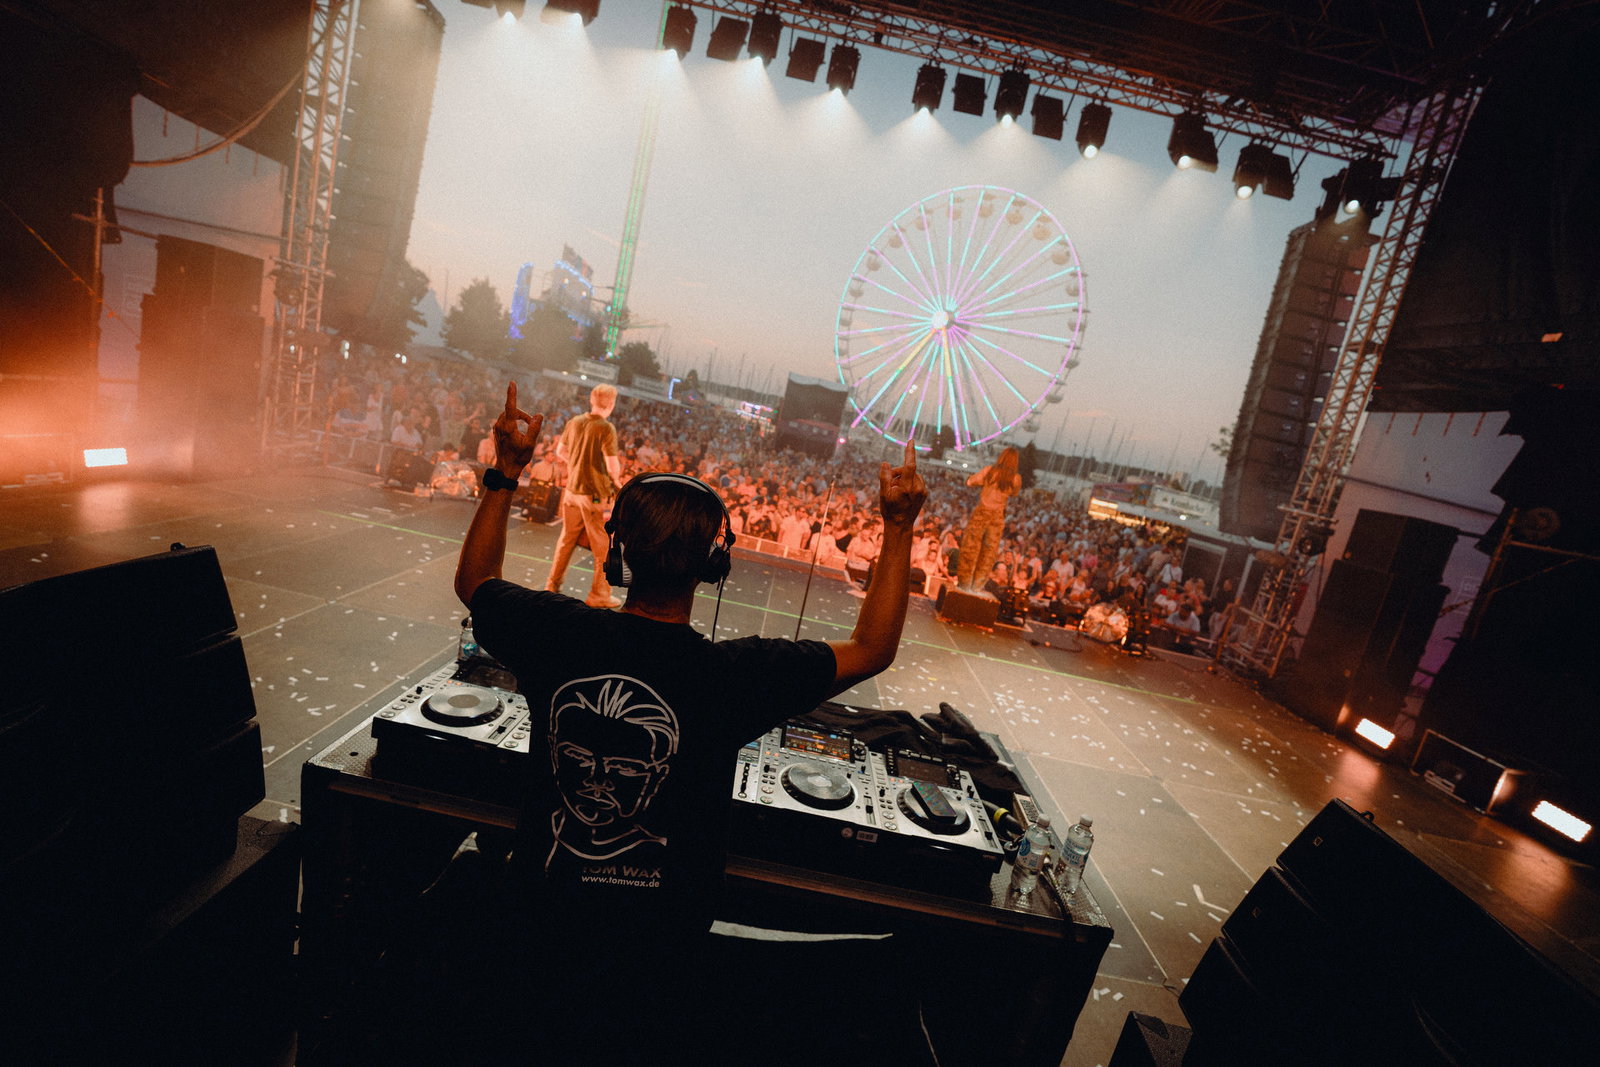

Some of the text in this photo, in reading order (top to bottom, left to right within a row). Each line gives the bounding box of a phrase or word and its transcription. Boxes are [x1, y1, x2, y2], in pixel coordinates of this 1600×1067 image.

[582, 864, 662, 879] OM WAX
[581, 875, 660, 888] www.tomwax.de
